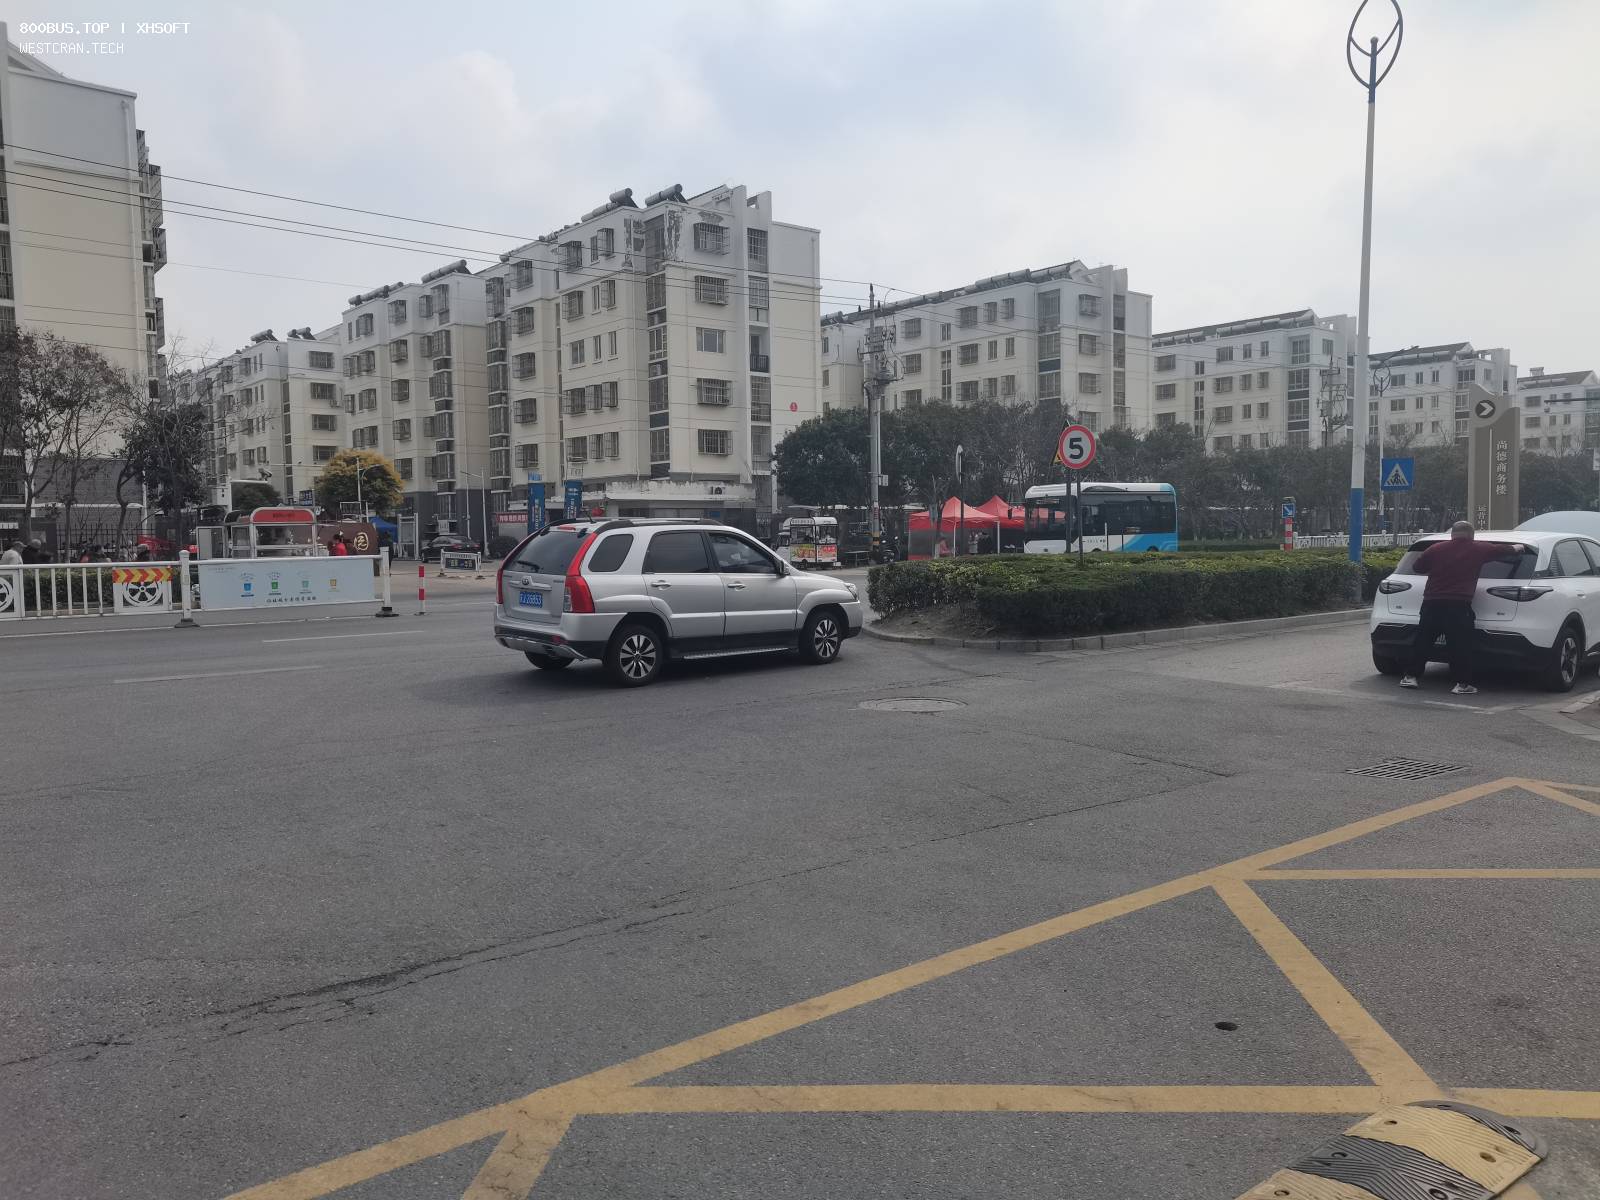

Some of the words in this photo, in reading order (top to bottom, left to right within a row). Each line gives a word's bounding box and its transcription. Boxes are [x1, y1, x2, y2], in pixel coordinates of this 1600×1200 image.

[1069, 437, 1084, 459] 5
[1496, 440, 1509, 496] 尚德商务楼
